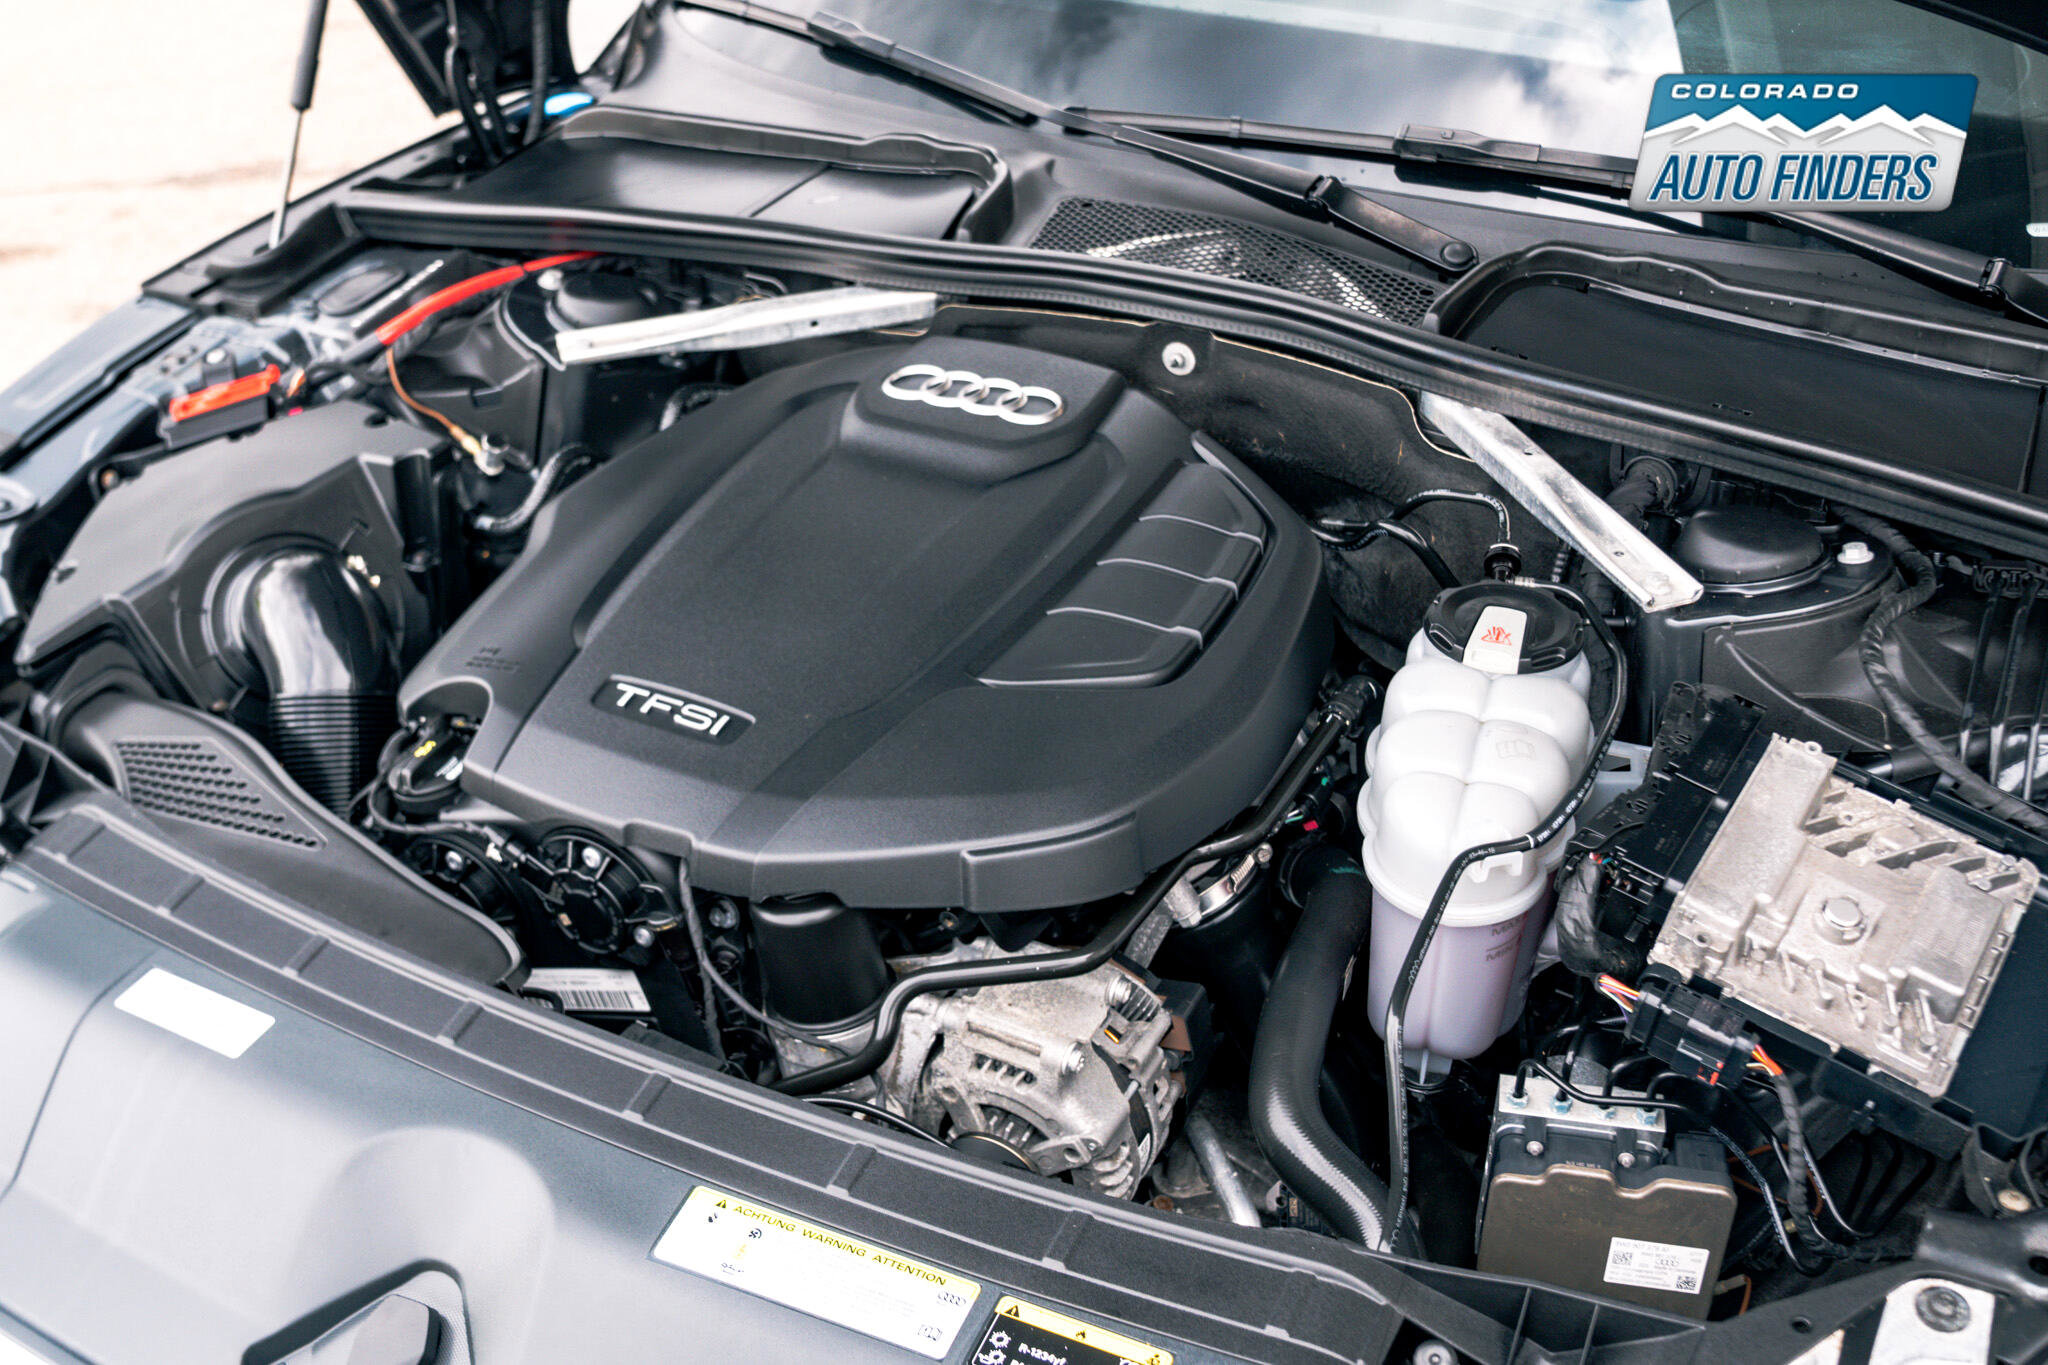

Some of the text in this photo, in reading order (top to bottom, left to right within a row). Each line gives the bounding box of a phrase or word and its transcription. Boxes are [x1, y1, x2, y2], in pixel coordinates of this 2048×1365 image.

[615, 683, 730, 735] TFSI
[733, 1205, 947, 1287] ACHTUNG WARNING ATTENTION
